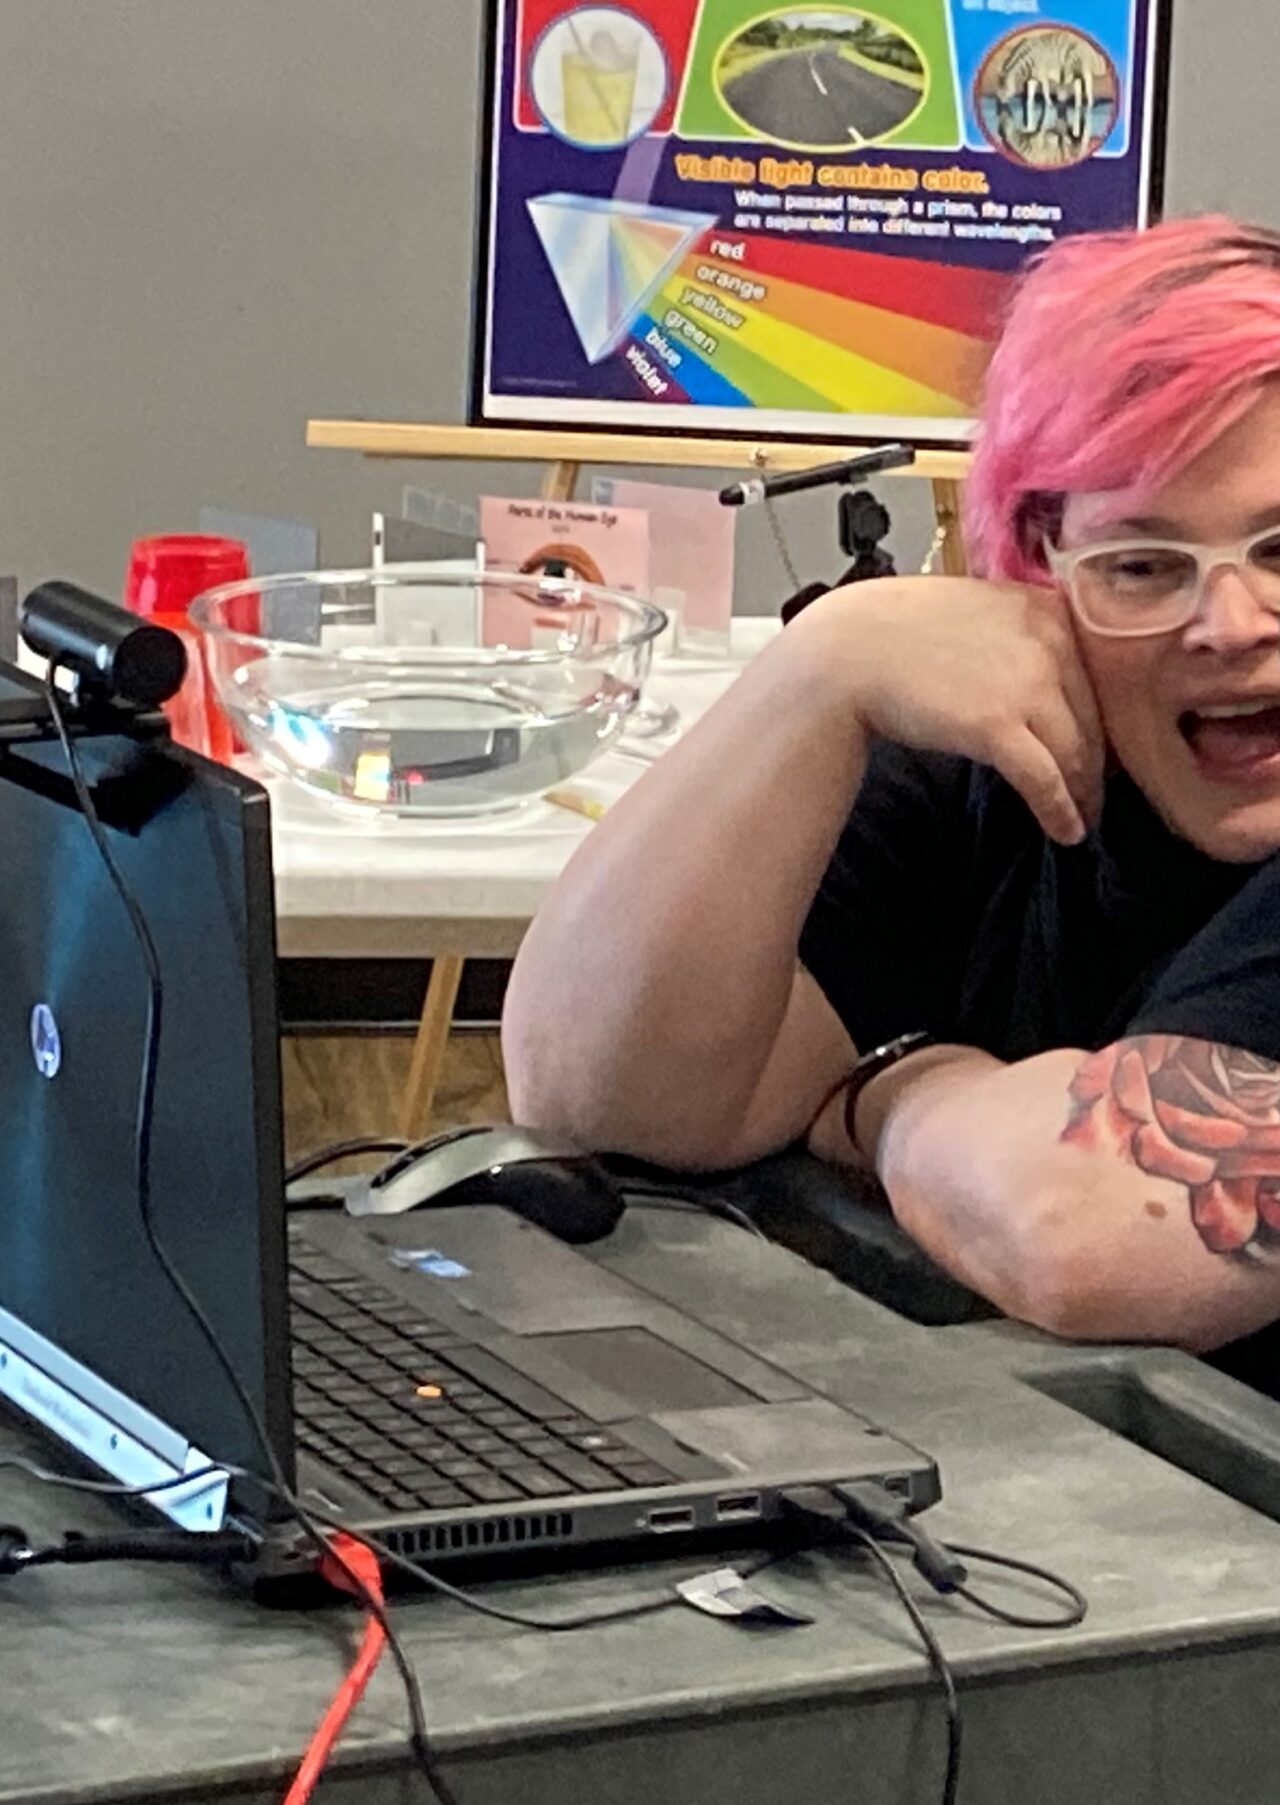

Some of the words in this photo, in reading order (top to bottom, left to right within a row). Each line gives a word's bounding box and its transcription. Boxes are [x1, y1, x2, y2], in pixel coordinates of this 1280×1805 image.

[674, 153, 756, 183] Visible
[759, 157, 814, 189] light
[817, 163, 918, 191] contains
[922, 166, 990, 194] color.
[734, 190, 781, 208] When
[785, 195, 844, 211] passed
[847, 195, 909, 216] through
[982, 202, 1008, 219] the
[1012, 203, 1062, 221] colors
[734, 213, 761, 228] are
[765, 215, 845, 232] separated
[848, 216, 879, 233] into
[882, 218, 950, 236] different
[710, 240, 746, 261] red
[697, 266, 766, 299] orange
[681, 288, 744, 329] yellow
[645, 327, 682, 369] blue
[665, 311, 718, 354] green
[626, 345, 669, 395] violet
